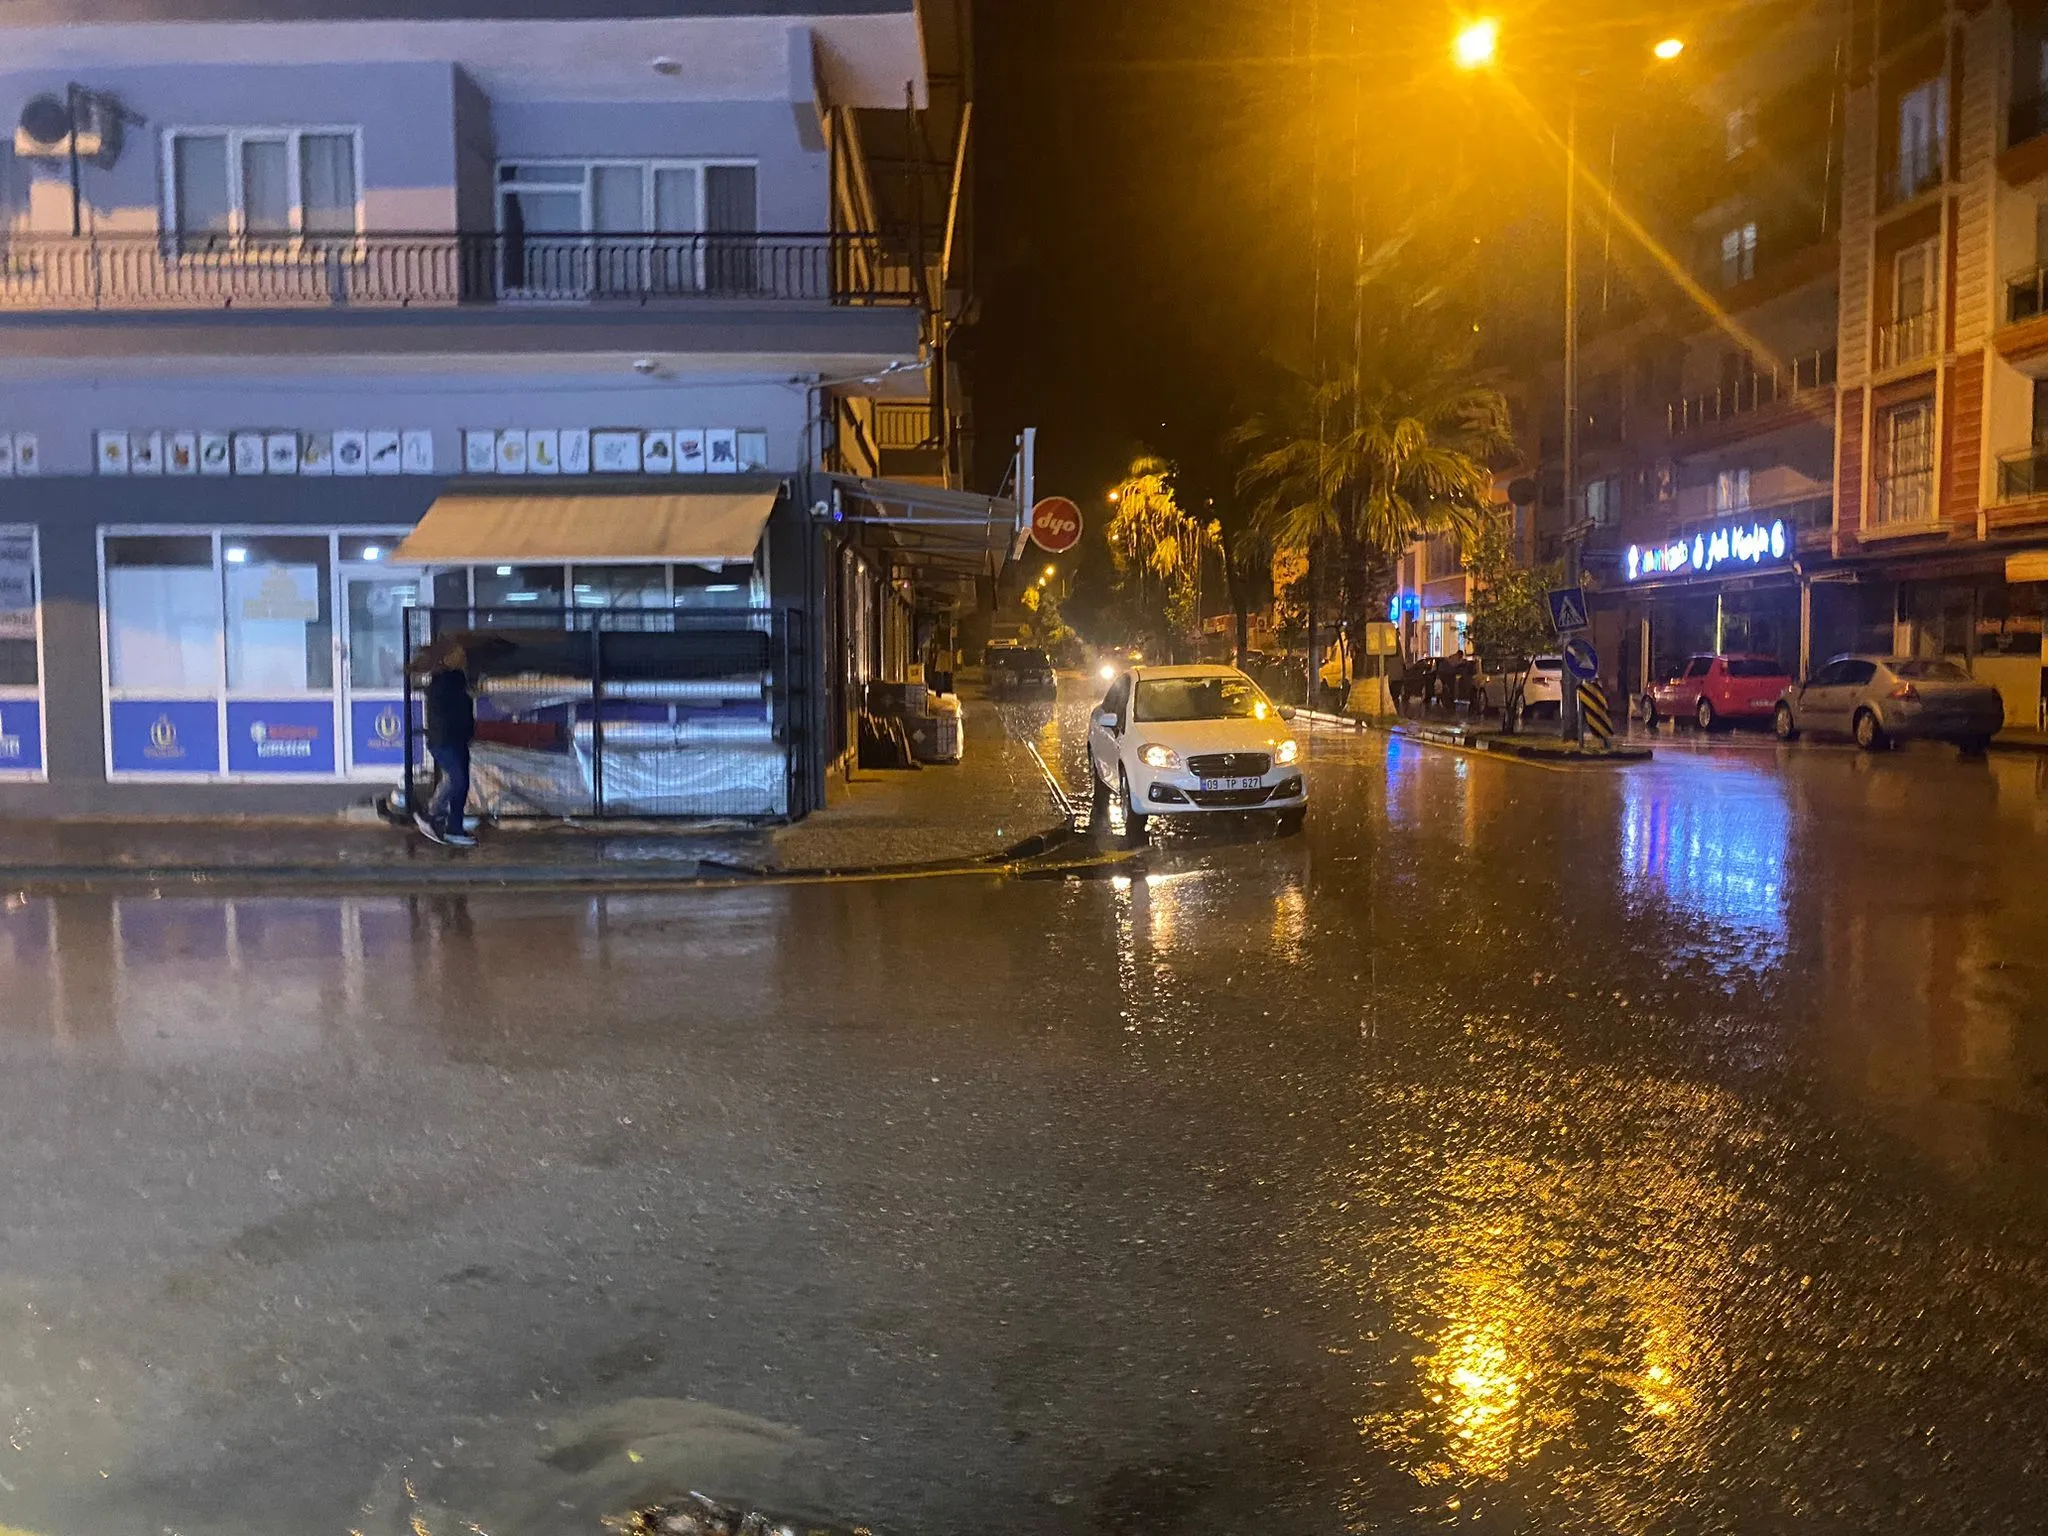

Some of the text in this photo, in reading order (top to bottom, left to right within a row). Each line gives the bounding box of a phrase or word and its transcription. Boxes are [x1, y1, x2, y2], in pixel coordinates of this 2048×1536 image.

[1037, 512, 1076, 536] dyo
[1207, 778, 1258, 789] 09 TP 627
